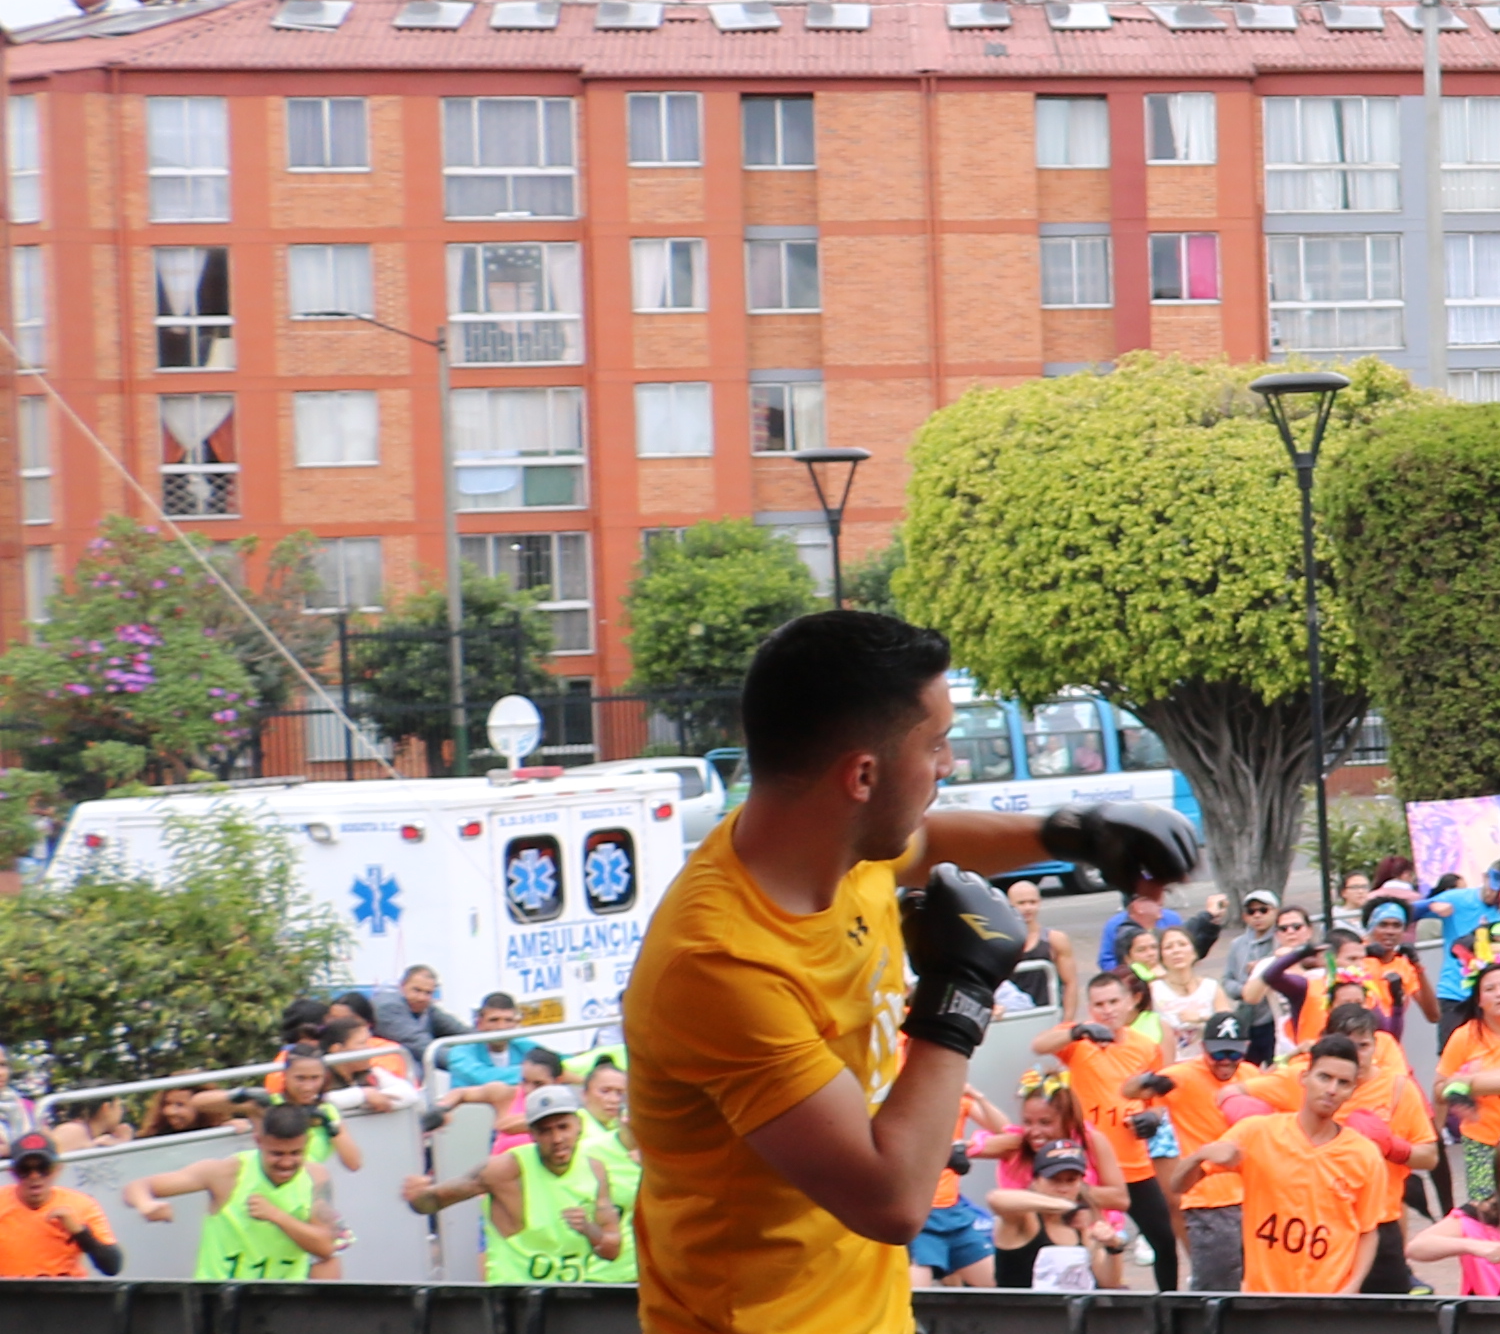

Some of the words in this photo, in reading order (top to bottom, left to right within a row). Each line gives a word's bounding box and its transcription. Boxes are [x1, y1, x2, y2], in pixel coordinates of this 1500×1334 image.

[505, 919, 645, 961] AMBULANCIA
[519, 964, 564, 994] TAM
[1255, 1212, 1332, 1261] 406
